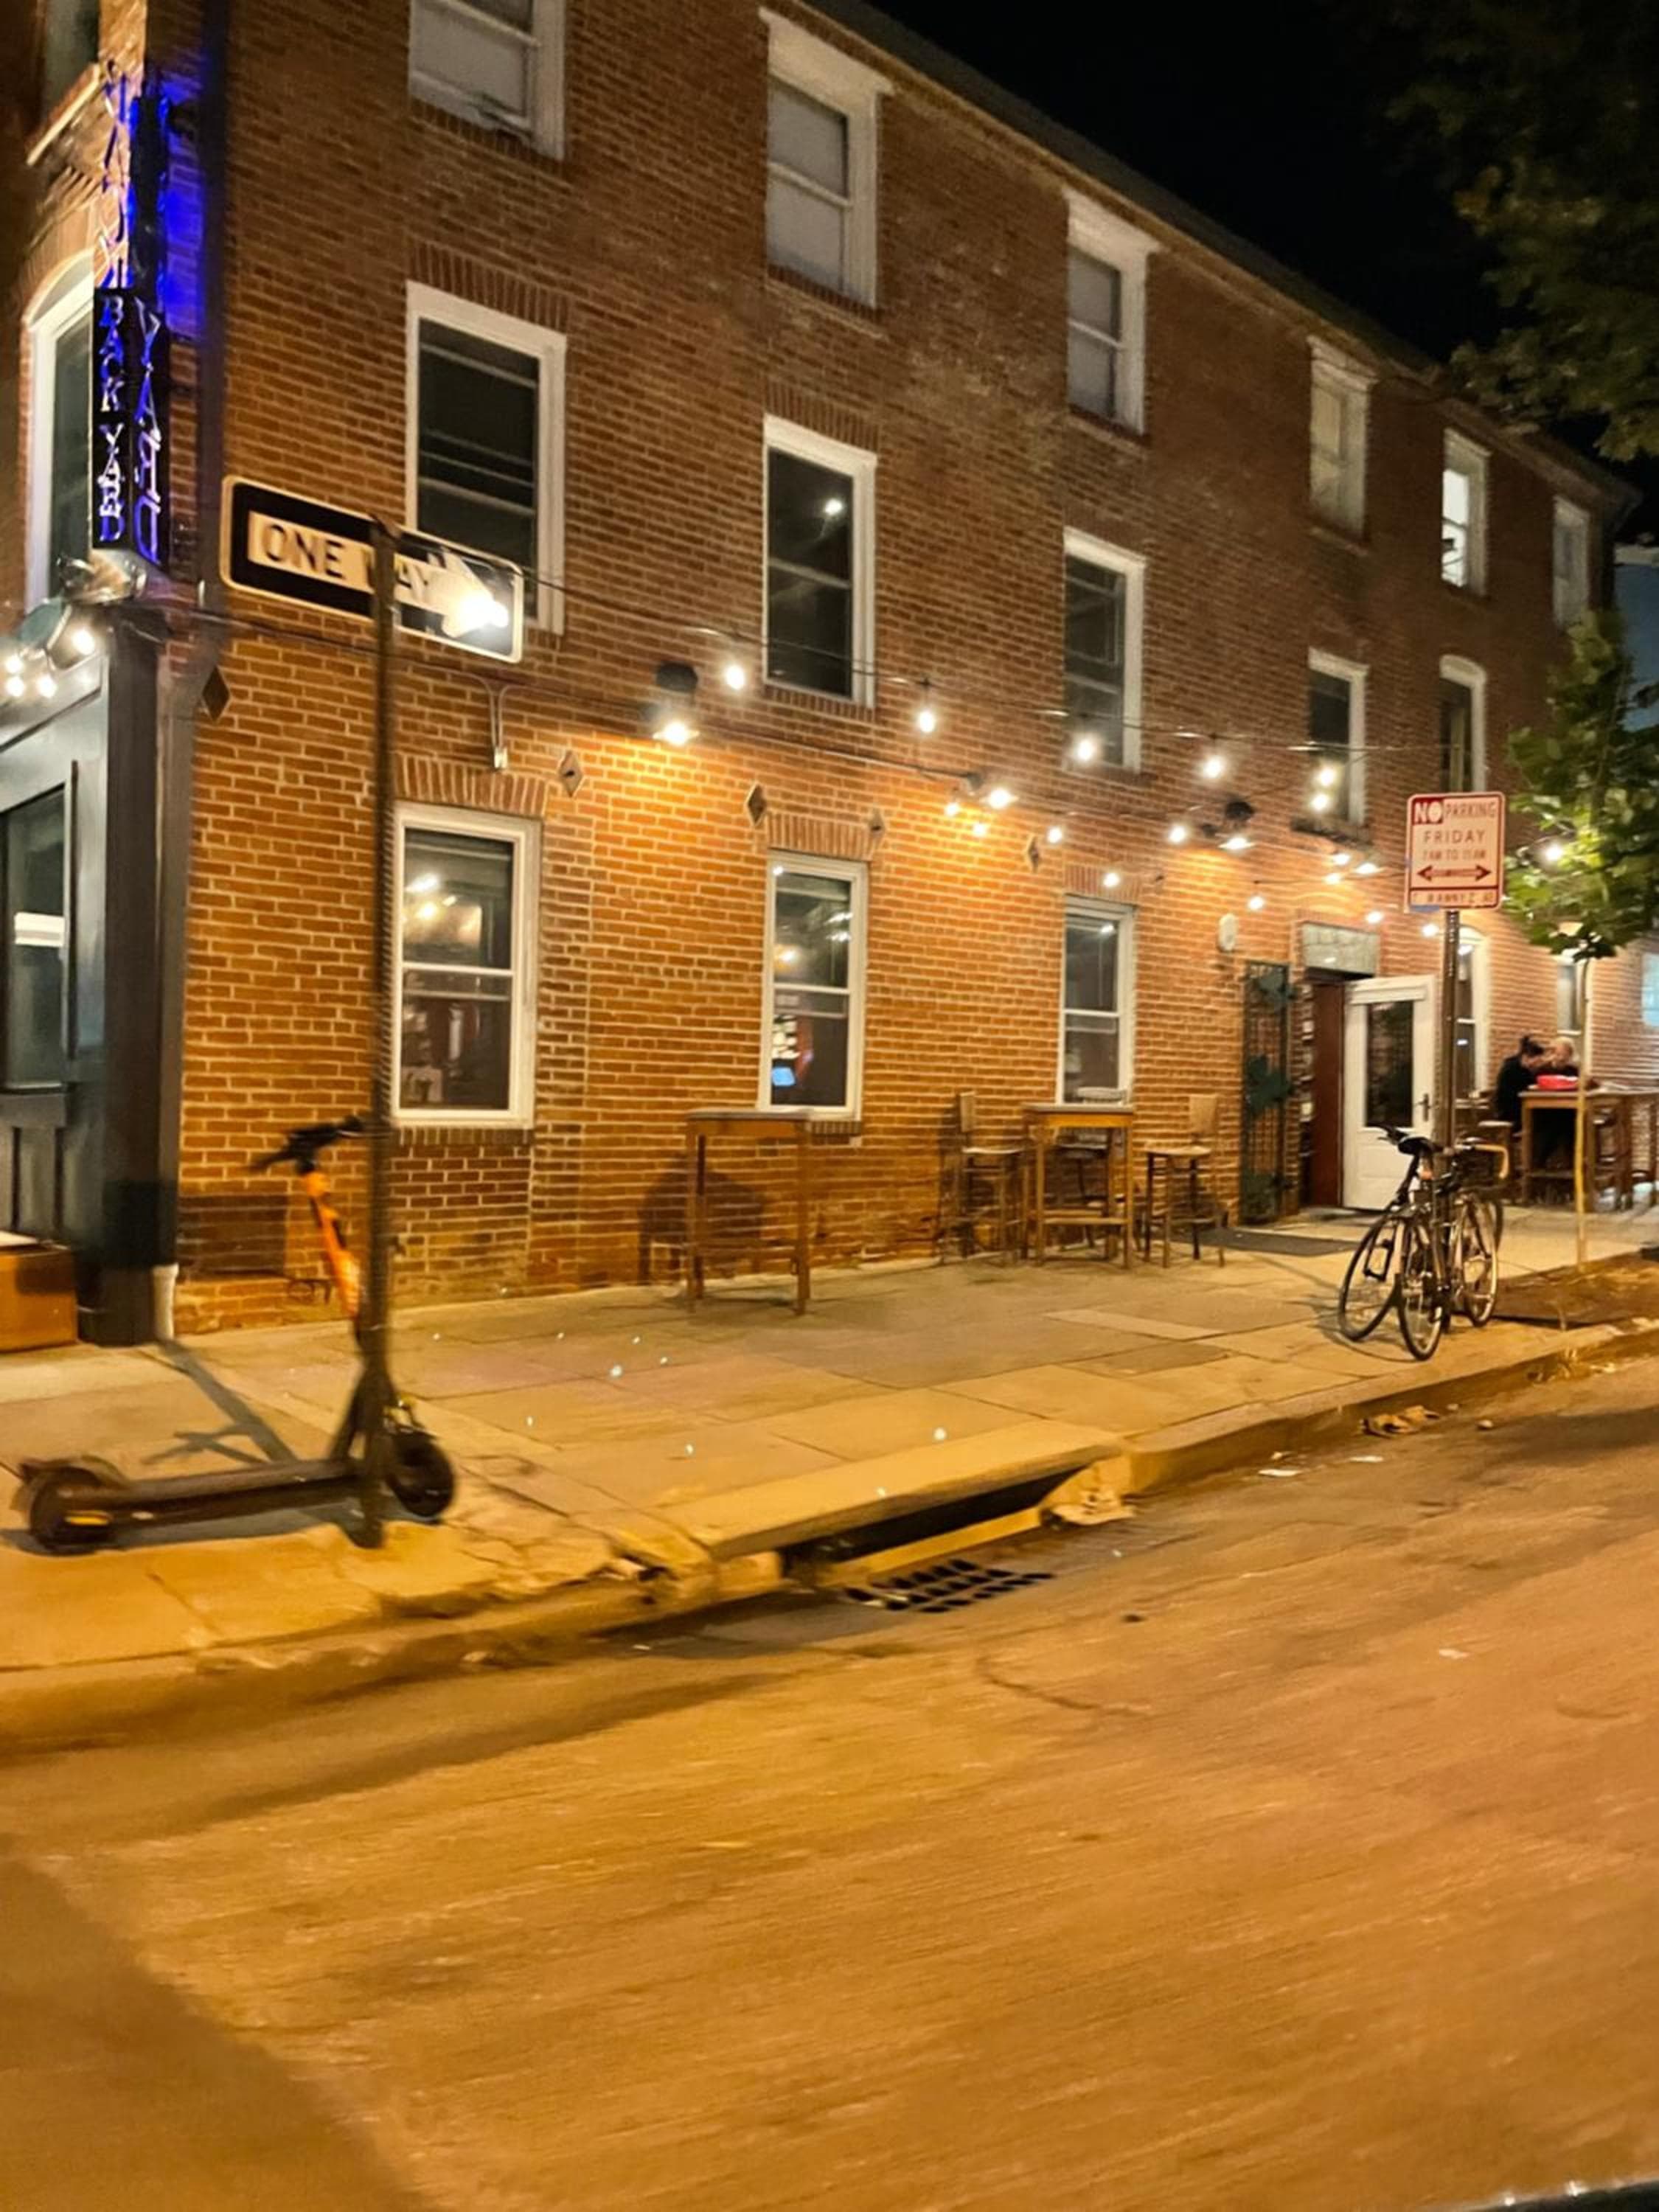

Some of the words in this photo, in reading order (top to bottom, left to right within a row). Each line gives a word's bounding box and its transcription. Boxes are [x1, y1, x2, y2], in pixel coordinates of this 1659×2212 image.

[98, 295, 125, 412] BACK
[97, 422, 126, 542] YARD
[261, 524, 346, 581] ONE
[1414, 801, 1443, 823] NO
[1424, 830, 1486, 844] FRIDAY
